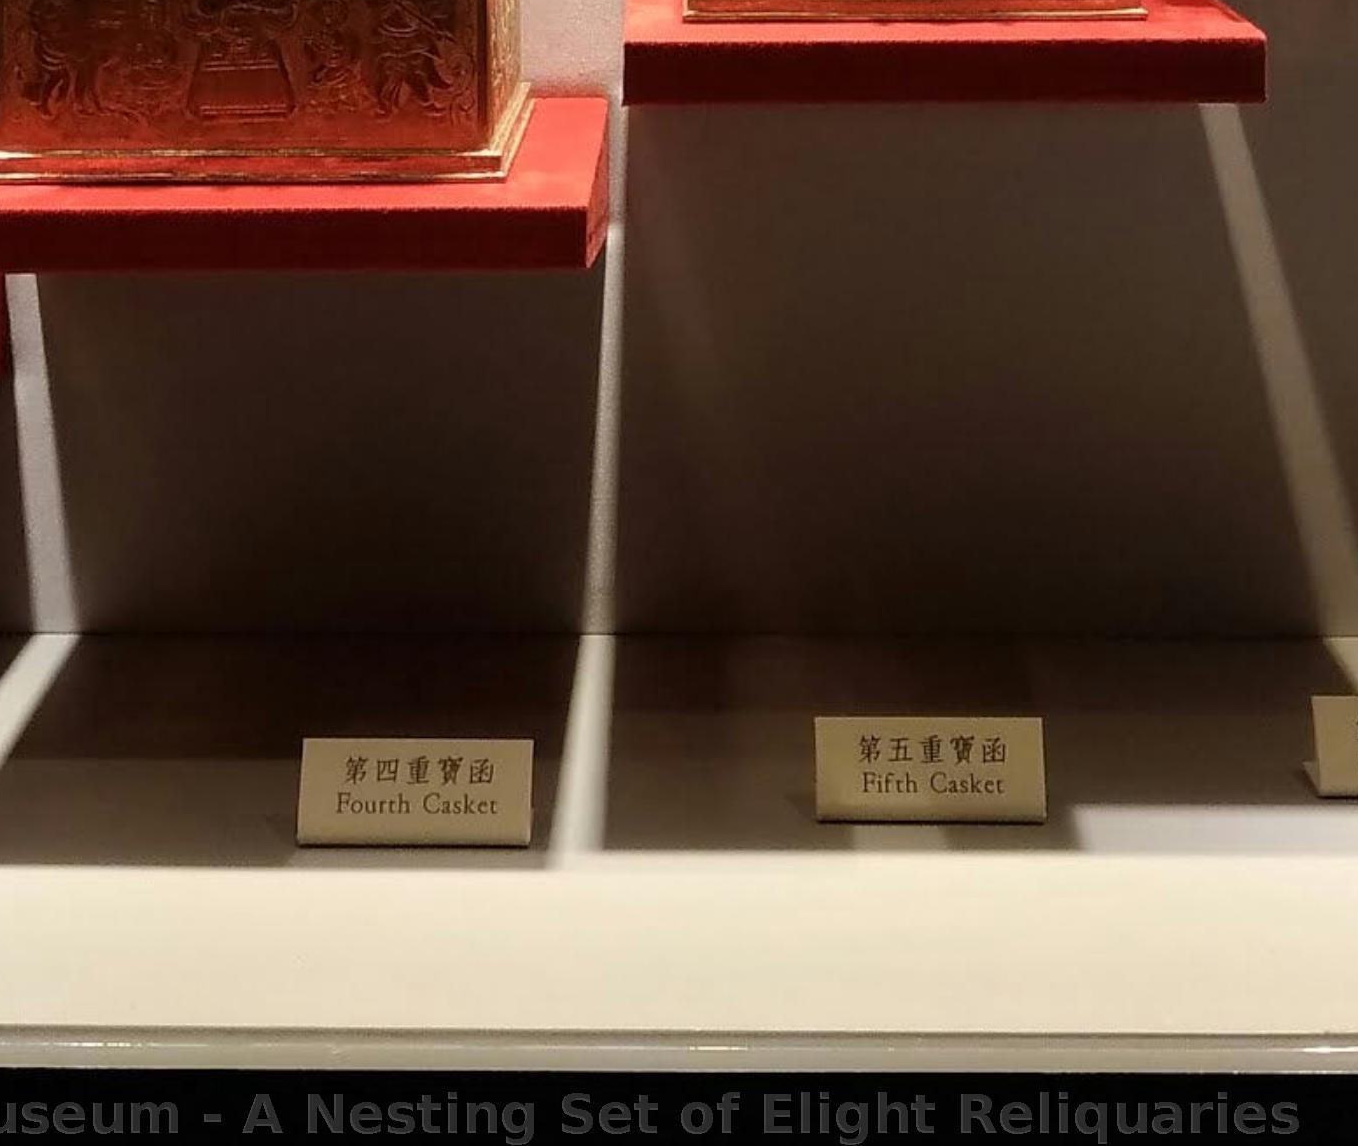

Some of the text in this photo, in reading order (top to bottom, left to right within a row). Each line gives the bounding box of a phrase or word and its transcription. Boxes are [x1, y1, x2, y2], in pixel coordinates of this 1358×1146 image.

[858, 733, 1007, 765] 第五重寶函
[344, 755, 495, 786] 第四重寶函
[862, 771, 1005, 794] Fifth Casket
[336, 791, 498, 815] Fourth Casket
